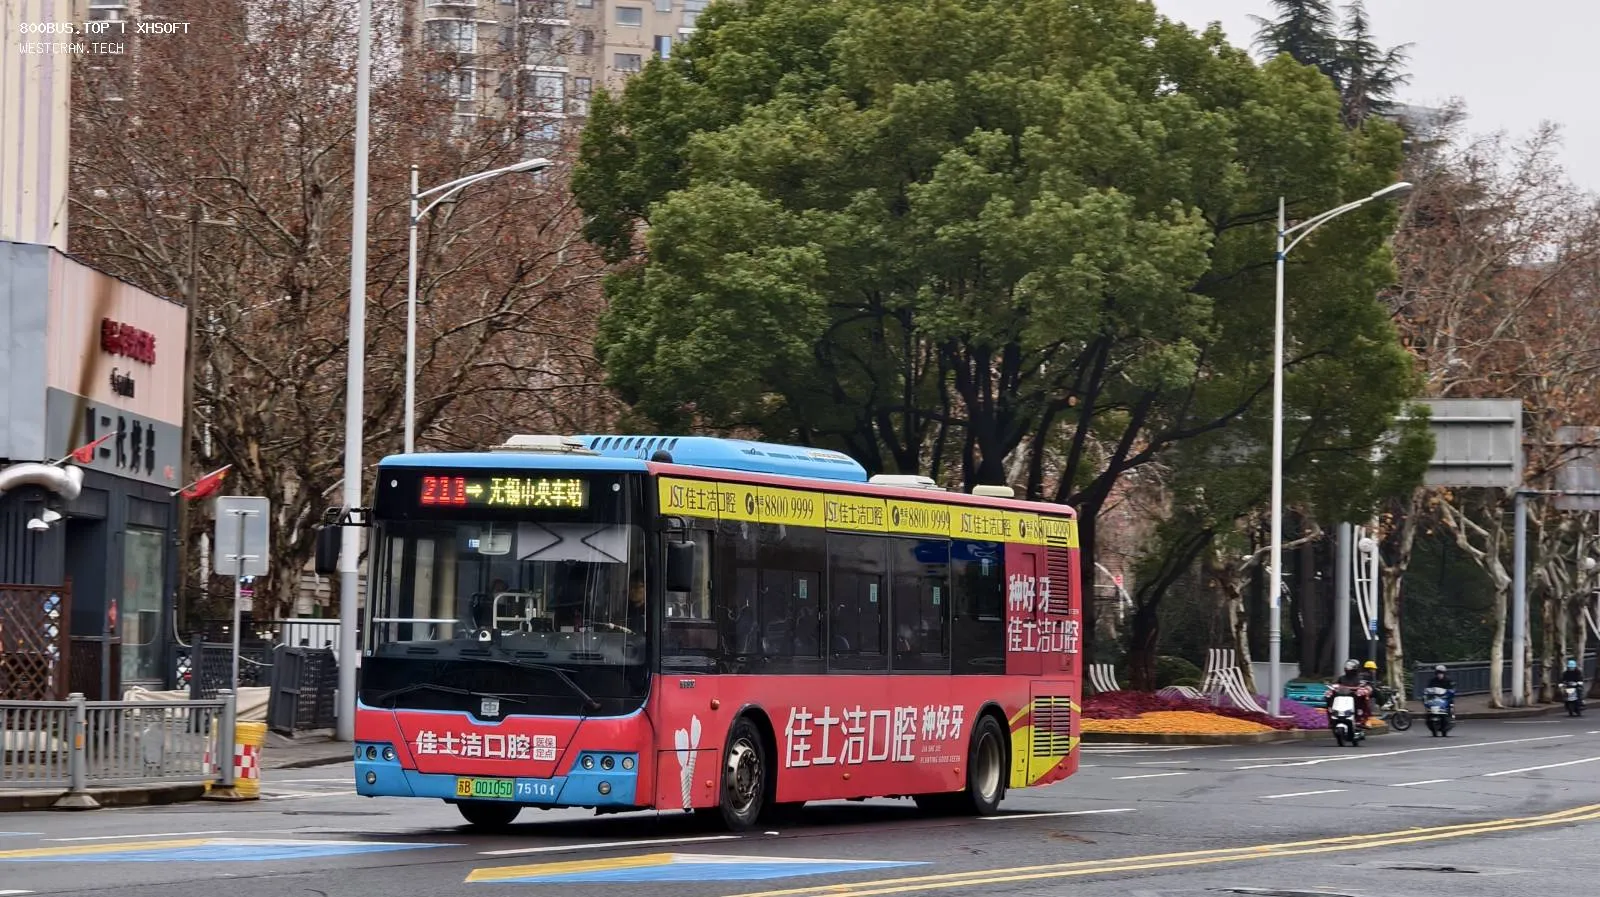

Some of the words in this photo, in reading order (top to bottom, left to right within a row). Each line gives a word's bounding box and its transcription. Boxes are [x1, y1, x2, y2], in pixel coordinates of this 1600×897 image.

[423, 476, 465, 504] 211
[488, 477, 582, 507] 无锡中央车站
[685, 487, 736, 513] 佳士洁口腔
[765, 495, 788, 517] 8800
[791, 497, 814, 520] 9999
[840, 502, 883, 525] 佳士洁口腔
[908, 508, 929, 529] 8800
[931, 509, 951, 531] 9999
[1009, 574, 1051, 613] 种好牙
[1008, 616, 1079, 653] 佳士洁口腔
[415, 730, 530, 759] 佳士洁口腔
[785, 705, 918, 768] 佳士洁口腔
[922, 705, 964, 741] 种好牙
